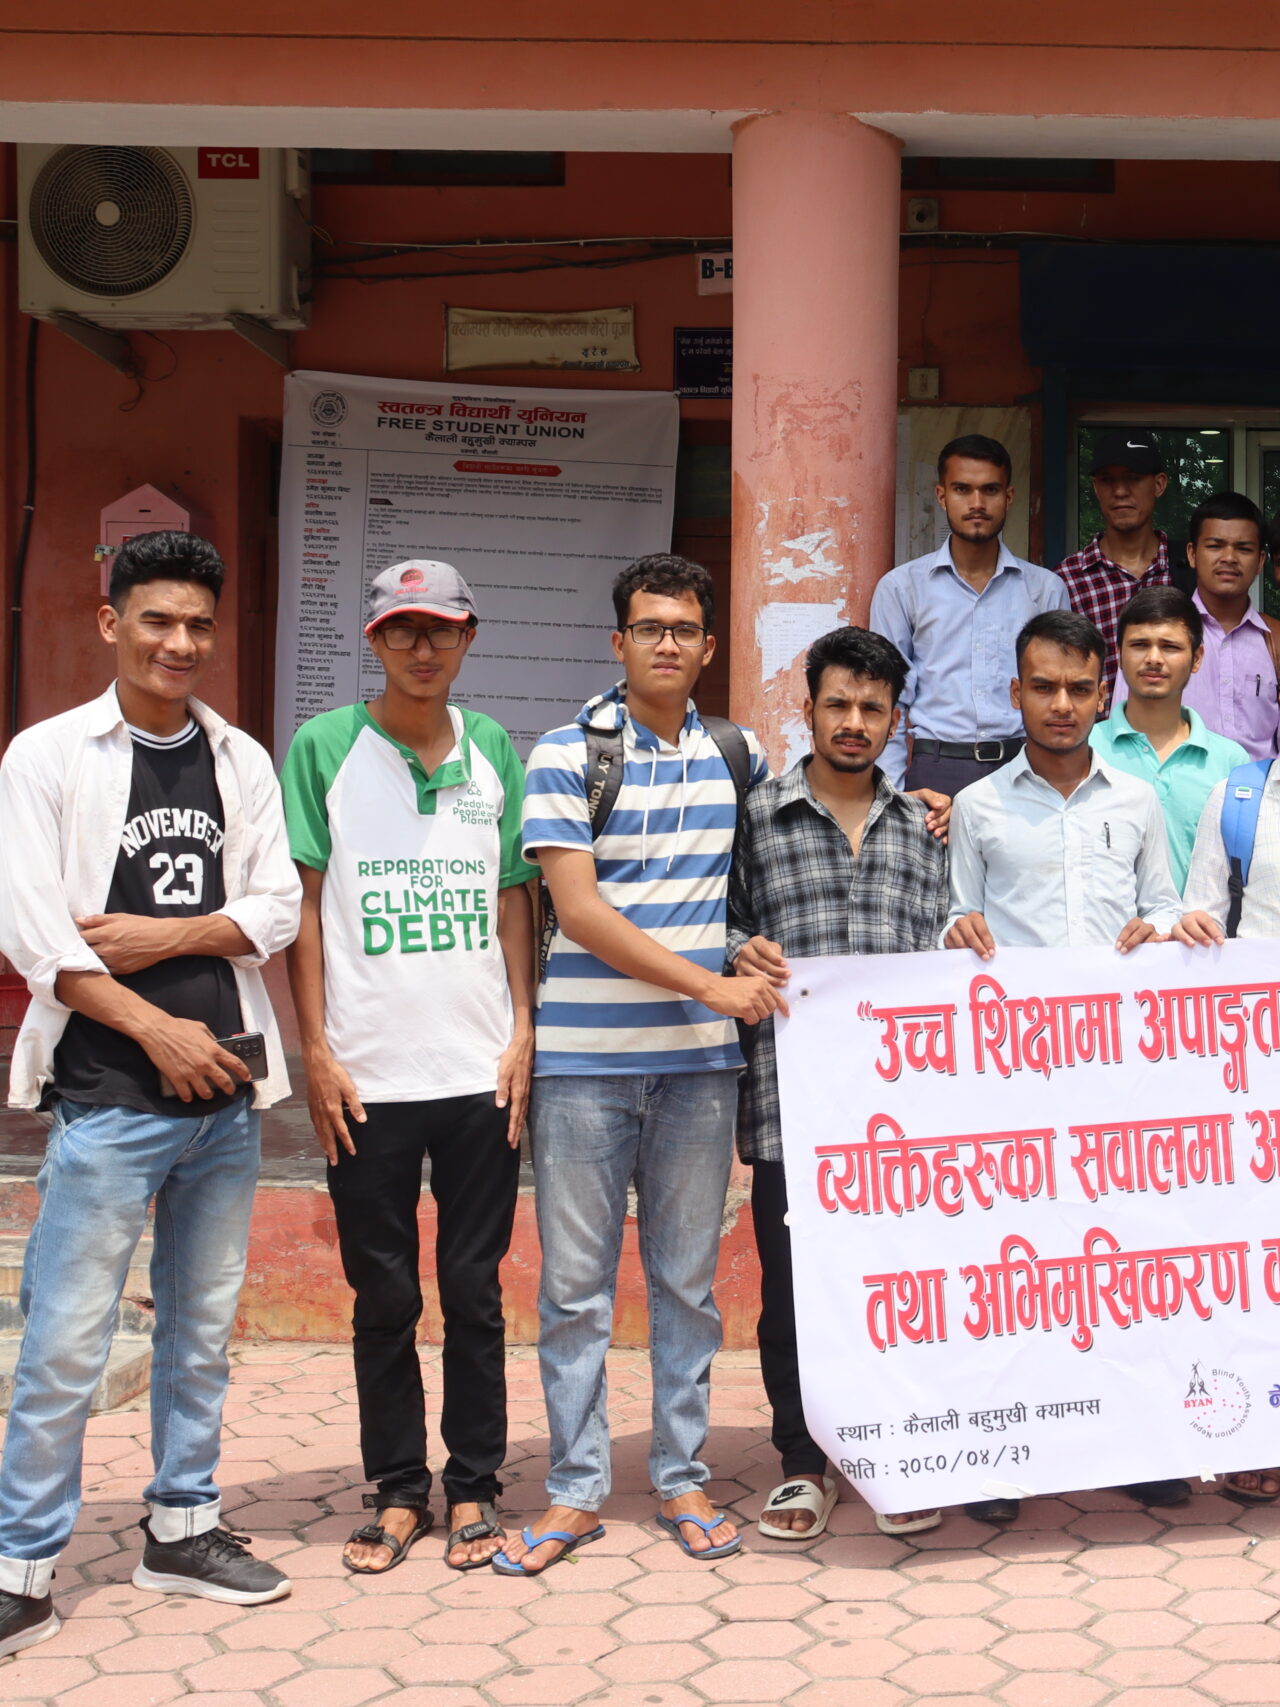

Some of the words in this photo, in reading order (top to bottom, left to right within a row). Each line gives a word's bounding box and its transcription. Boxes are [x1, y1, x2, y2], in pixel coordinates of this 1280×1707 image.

[206, 153, 251, 168] TCL
[377, 401, 444, 416] स्वतन्त्र
[450, 402, 512, 420] विद्यार्थी
[377, 417, 426, 431] FREE
[432, 420, 521, 435] STUDENT
[526, 425, 585, 439] UNION
[452, 807, 487, 818] People
[457, 798, 485, 809] Pedal
[461, 815, 494, 826] Planet
[120, 808, 225, 858] NOVEMBER
[149, 852, 204, 905] 23
[357, 858, 486, 877] REPARATIONS
[410, 875, 444, 889] FOR
[361, 889, 489, 915] CLIMATE
[362, 913, 490, 956] DEBT!
[969, 974, 1122, 1080] शिक्षामा
[1068, 1114, 1234, 1203] सवालमा
[863, 1269, 947, 1353] तथा
[959, 1227, 1250, 1353] अभिमुखिकरण
[1211, 1368, 1235, 1380] Blind
[1235, 1375, 1251, 1400] Youth
[1184, 1398, 1213, 1409] BYAN
[836, 1423, 882, 1443] स्थान
[903, 1409, 960, 1435] कैलाली
[968, 1402, 1028, 1433] बहुमुखी
[1035, 1399, 1101, 1420] क्याम्पस
[1189, 1420, 1213, 1440] Nepal
[1214, 1401, 1253, 1439] Association
[840, 1458, 876, 1480] मिति
[779, 1484, 808, 1498] NIKE
